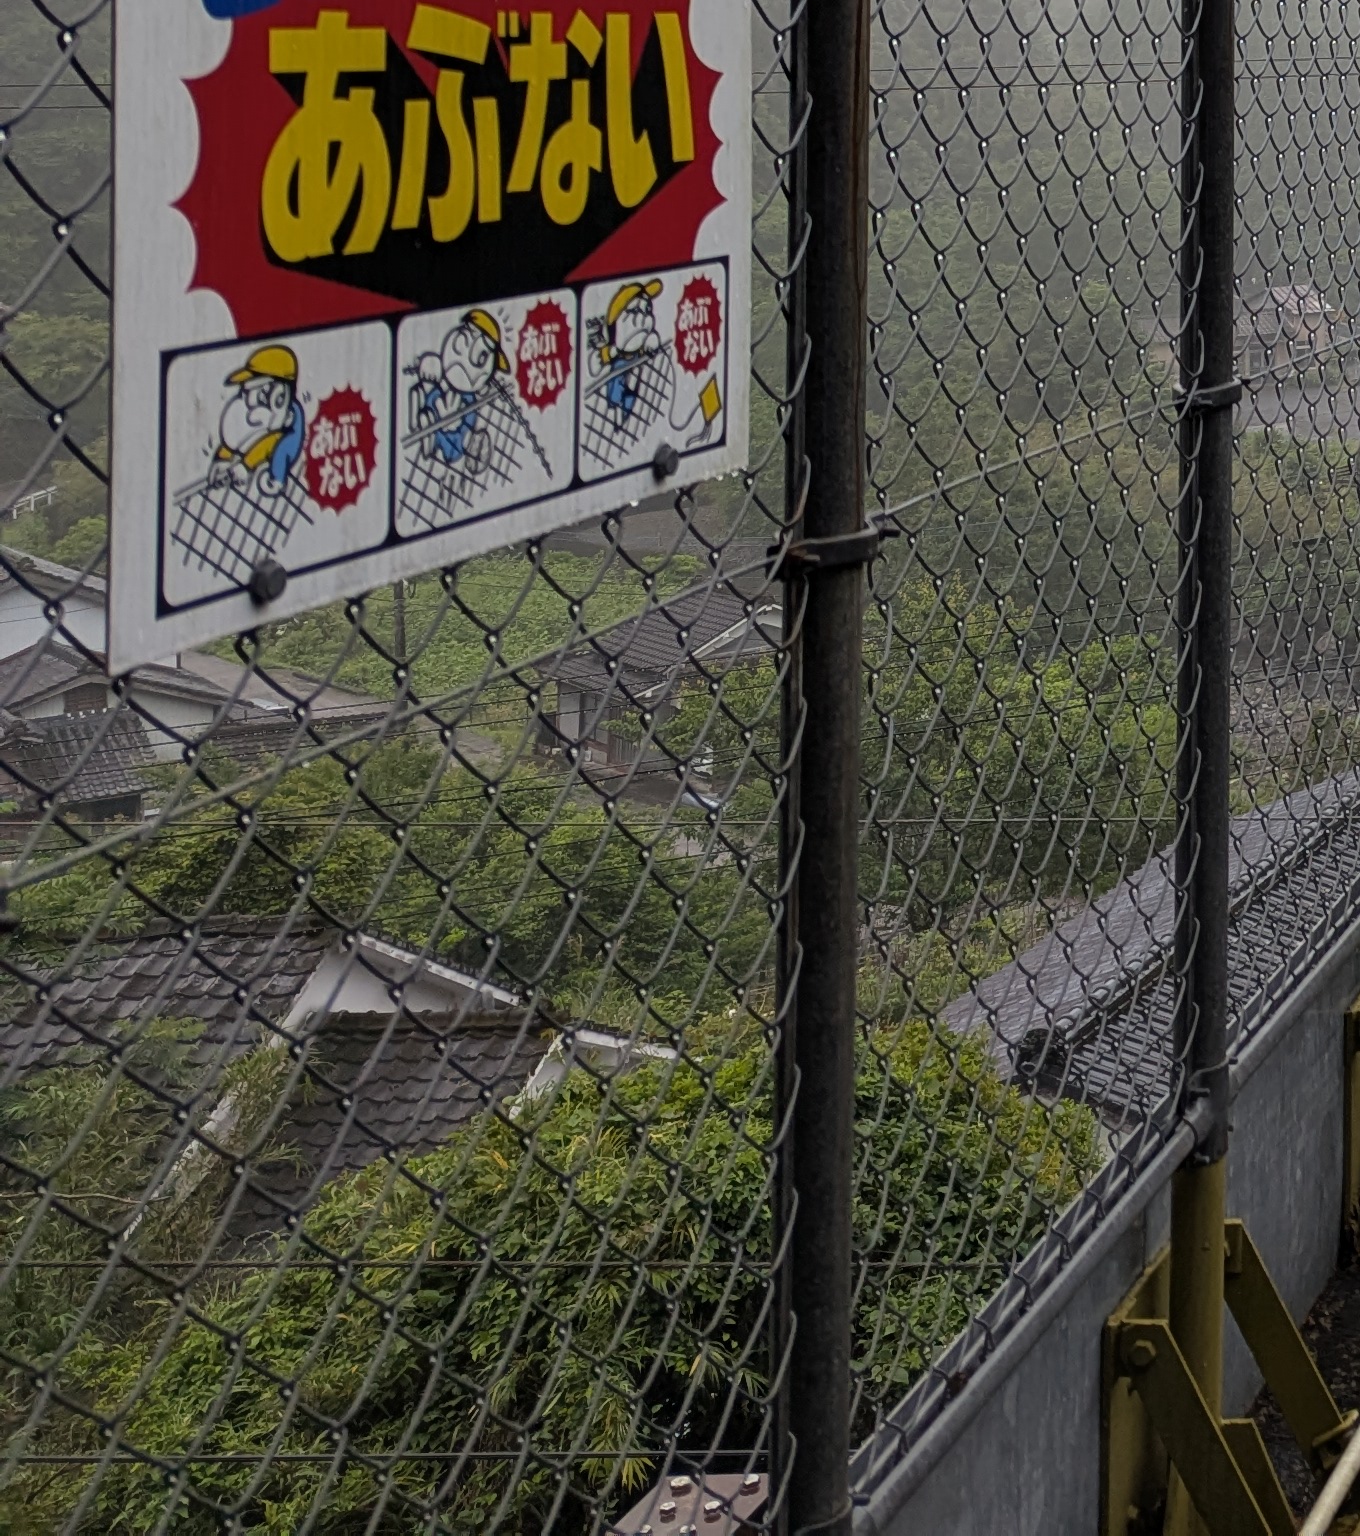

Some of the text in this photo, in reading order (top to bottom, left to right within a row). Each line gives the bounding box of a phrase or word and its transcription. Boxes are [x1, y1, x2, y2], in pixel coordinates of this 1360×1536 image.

[261, 3, 694, 263] あぶない
[520, 322, 560, 362] あぶ
[527, 359, 563, 397] ない
[310, 412, 362, 459] あぶ
[319, 453, 366, 497] ない
